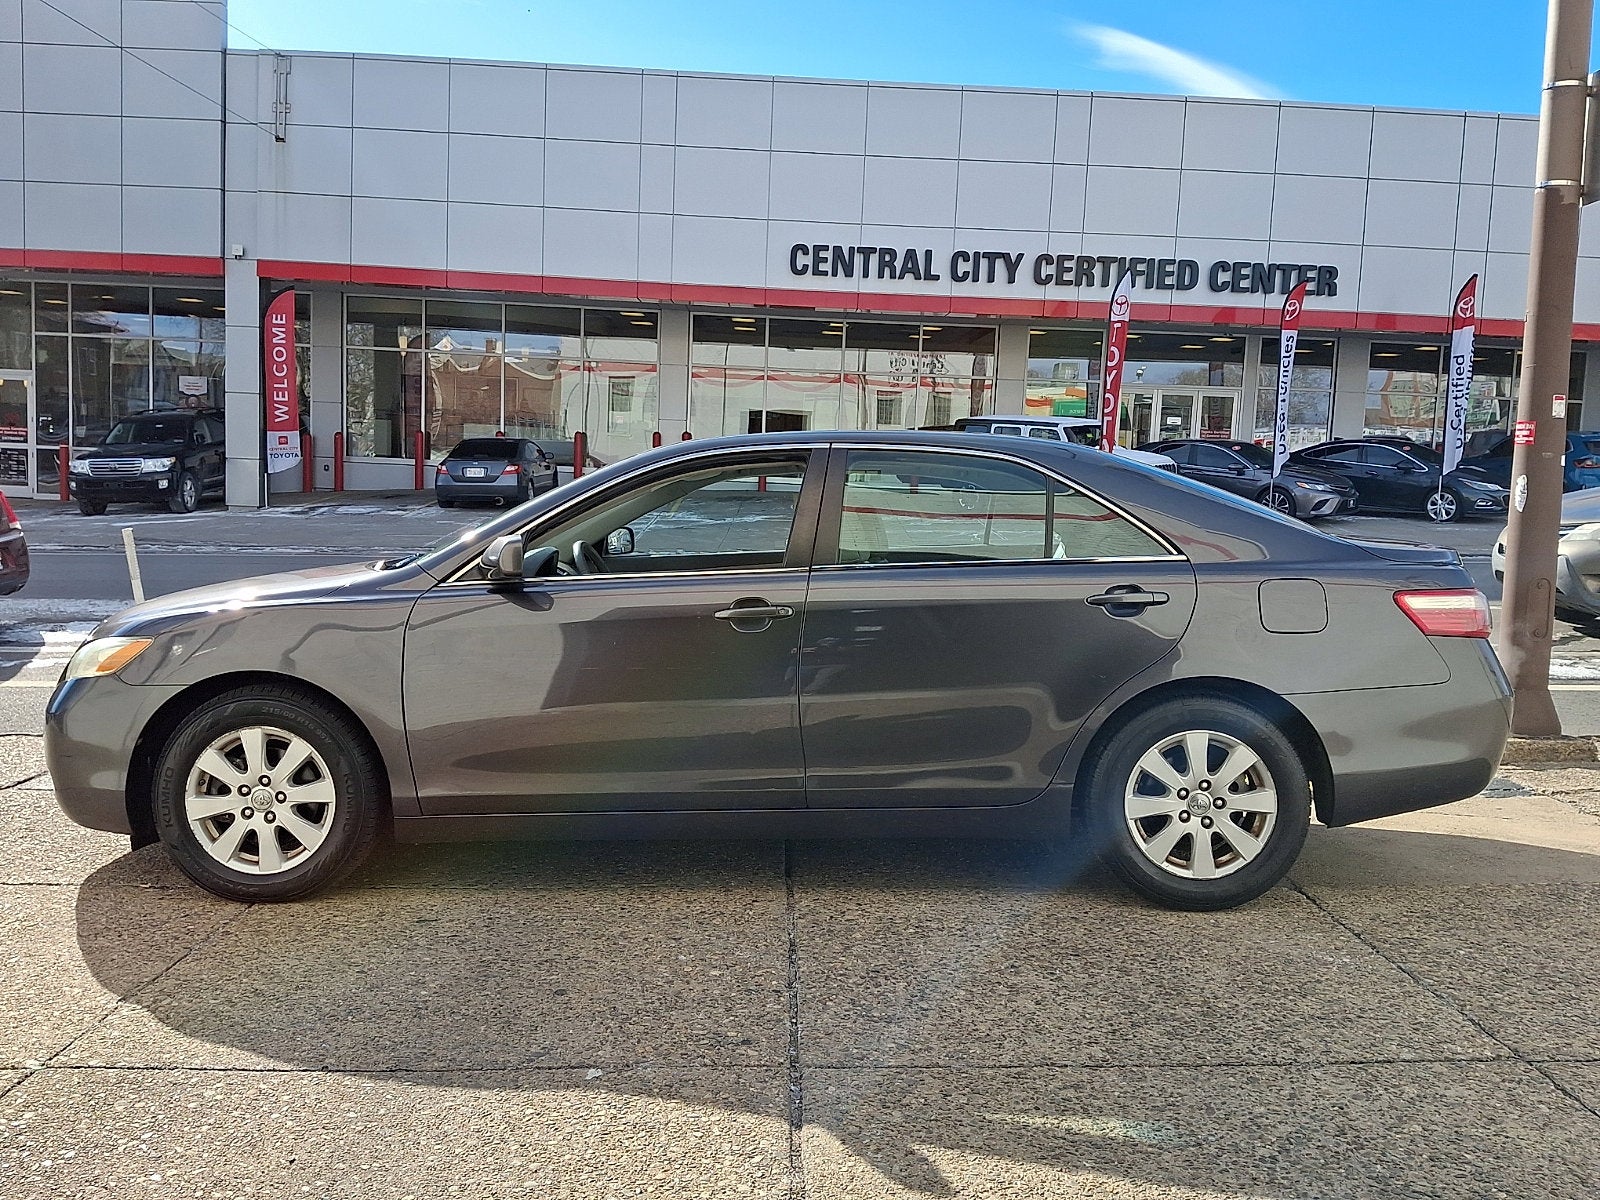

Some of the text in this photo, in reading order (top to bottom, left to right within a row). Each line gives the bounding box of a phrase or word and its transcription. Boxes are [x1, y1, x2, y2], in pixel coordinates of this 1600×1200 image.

[789, 243, 1339, 297] CENTRAL CITY CERTIFIED CENTER
[272, 313, 290, 423] WELCOME
[1450, 354, 1465, 431] Certified
